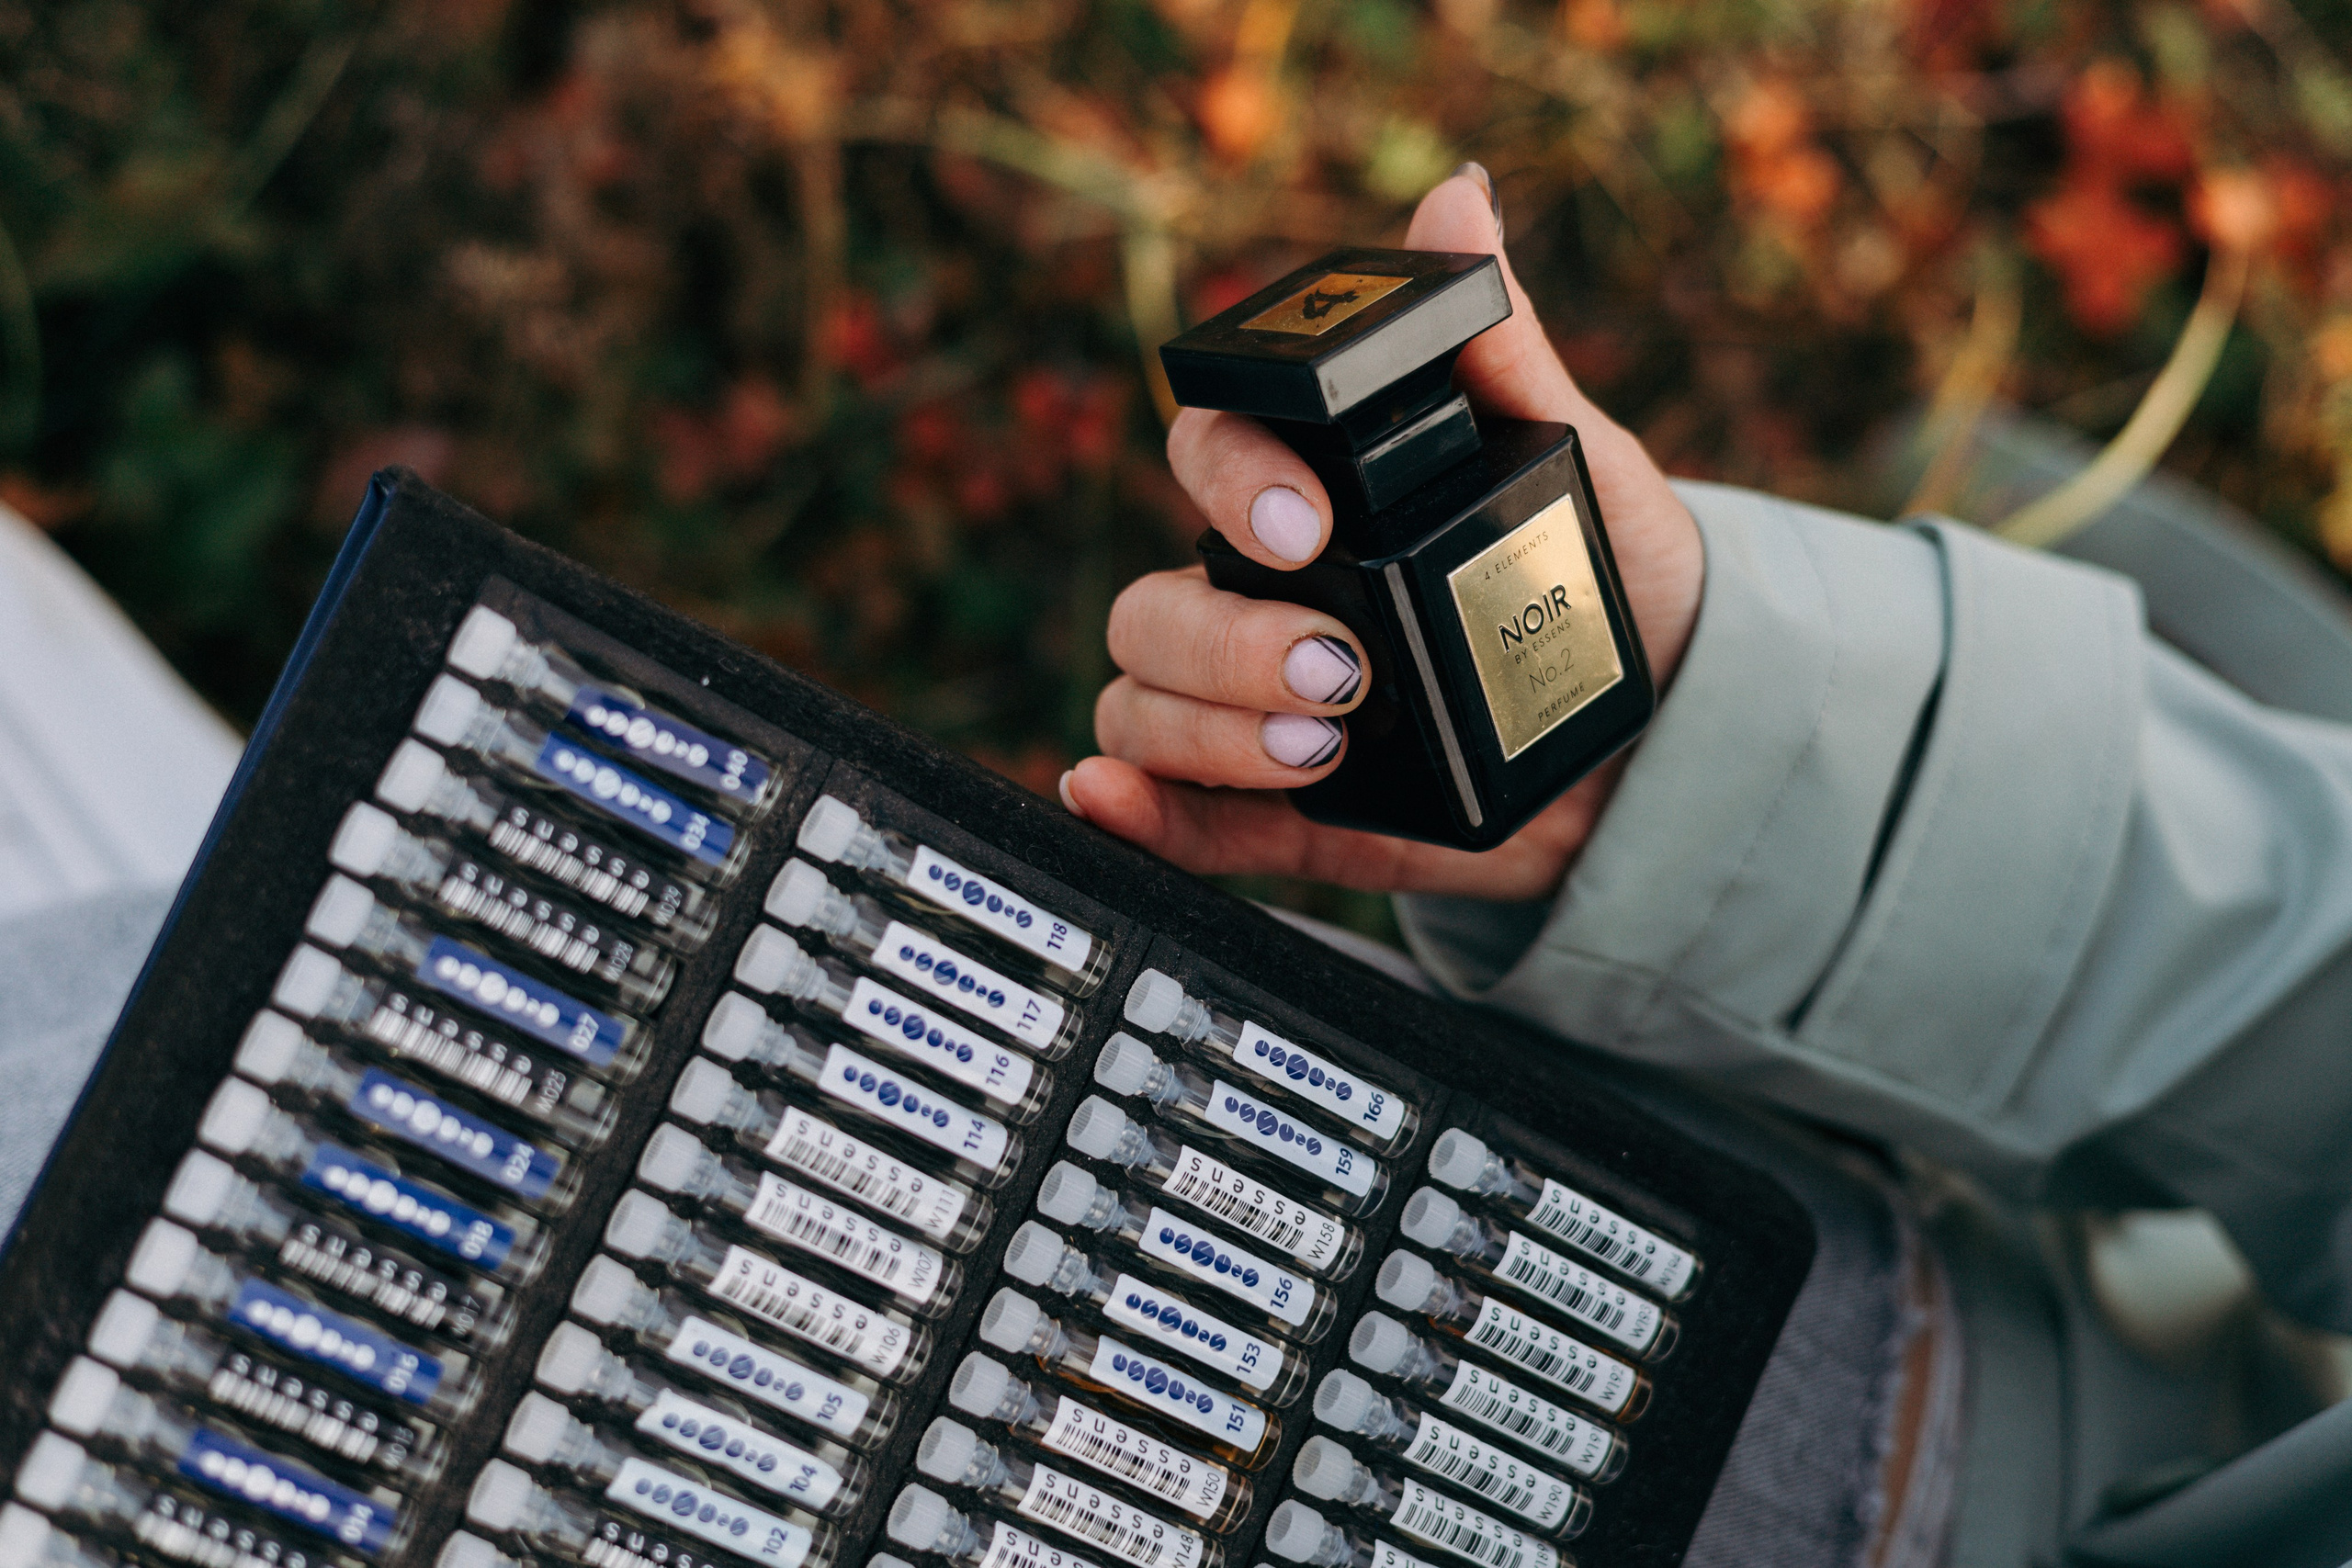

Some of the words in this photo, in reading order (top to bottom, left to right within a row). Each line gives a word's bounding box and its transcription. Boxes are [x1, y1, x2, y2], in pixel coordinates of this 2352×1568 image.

[1485, 570, 1491, 581] 4
[1495, 531, 1549, 575] ELEMENTS
[1498, 584, 1572, 653] NOIR
[1515, 649, 1528, 665] BY
[1532, 619, 1572, 653] ESSENS
[1538, 682, 1586, 722] PERFUME
[677, 812, 712, 852] 034
[1046, 922, 1069, 952] 118
[567, 1012, 600, 1053] 027
[1016, 999, 1043, 1033] 117
[985, 1054, 1011, 1089] 116
[1363, 1092, 1385, 1122] 166
[963, 1118, 988, 1151] 114
[500, 1143, 535, 1184] 024
[797, 1120, 924, 1192] essens
[1335, 1148, 1354, 1177] 159
[924, 1190, 957, 1230] W111
[1190, 1157, 1306, 1225] essens
[775, 1183, 902, 1253] essens
[1551, 1189, 1656, 1255] essens
[459, 1220, 494, 1260] 018
[1306, 1222, 1337, 1260] W158
[908, 1251, 936, 1289] W107
[1521, 1241, 1626, 1305] essens
[740, 1259, 868, 1330] essens
[1269, 1278, 1294, 1311] 156
[1491, 1307, 1598, 1369] essens
[1627, 1303, 1653, 1339] W193
[870, 1326, 901, 1366] W106
[1236, 1342, 1261, 1376] 153
[1470, 1370, 1576, 1431] essens
[1599, 1365, 1624, 1403] W192
[816, 1393, 843, 1422] 105
[1226, 1404, 1247, 1434] 151
[1072, 1408, 1192, 1474] essens
[1430, 1426, 1536, 1488] essens
[1577, 1426, 1604, 1465] W191
[789, 1464, 818, 1493] 104
[1195, 1472, 1222, 1509] W150
[1045, 1472, 1164, 1539] essens
[1415, 1488, 1522, 1548] essens
[1535, 1484, 1563, 1521] W190
[602, 1522, 714, 1568] sens
[762, 1527, 788, 1556] 102
[1534, 1543, 1550, 1568] 189
